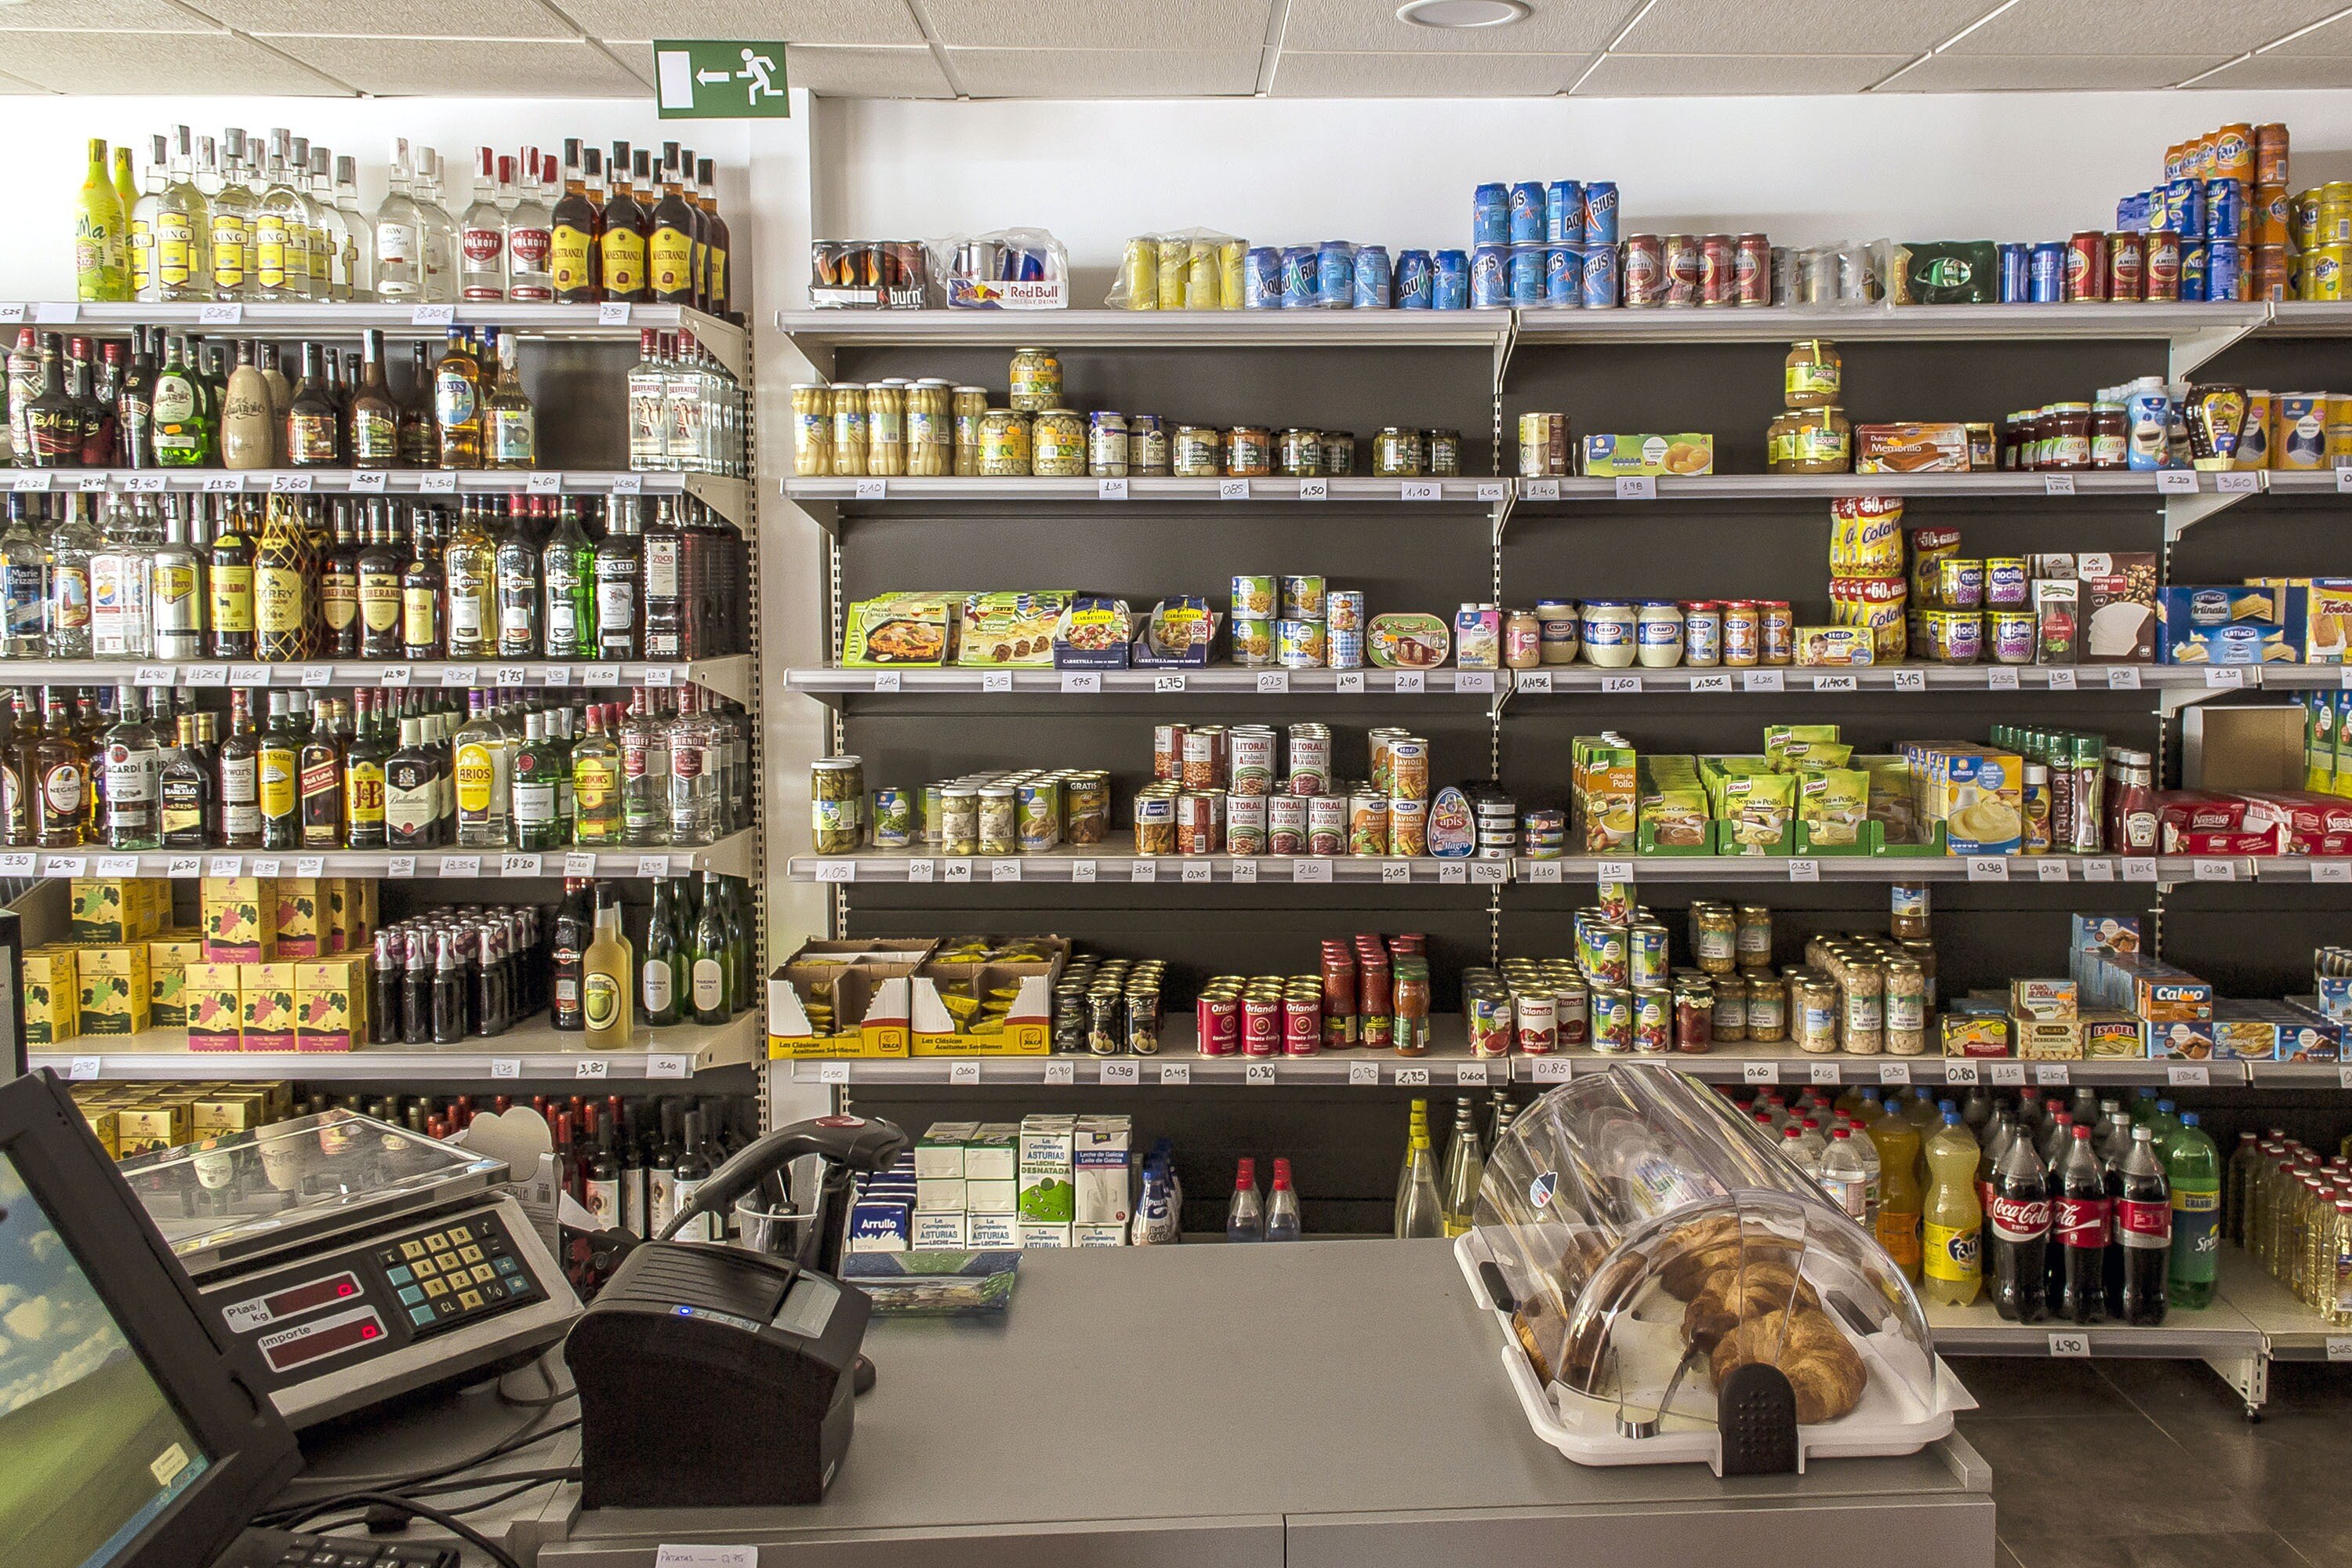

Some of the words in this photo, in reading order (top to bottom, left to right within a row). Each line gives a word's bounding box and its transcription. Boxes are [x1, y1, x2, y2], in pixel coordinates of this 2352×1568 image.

[890, 288, 919, 304] burn
[1011, 286, 1034, 298] Red
[1036, 285, 1058, 298] Bull
[1871, 443, 1921, 452] Membrillo
[274, 478, 307, 489] 5,60
[425, 478, 453, 488] 4.50
[532, 477, 555, 486] 4.60
[2220, 477, 2252, 489] 3,60
[1301, 485, 1324, 495] 1,50
[1406, 487, 1430, 496] 1,10
[1531, 485, 1555, 495] 1.40
[653, 554, 673, 563] ZOCO
[12, 569, 38, 579] Marie
[587, 669, 613, 680] 16.50
[1158, 676, 1181, 689] 1,75
[1398, 676, 1417, 687] 2.10
[1610, 679, 1634, 689] 1,60
[1236, 742, 1268, 750] LITORAL
[303, 776, 315, 785] Red
[316, 770, 333, 781] Label
[1070, 782, 1097, 790] GRATIS
[1229, 801, 1262, 810] LITORAL
[1269, 801, 1301, 810] LITORAL
[1814, 797, 1831, 805] Sopa
[1440, 818, 1463, 829] apis
[2194, 815, 2228, 827] Nestlé
[1443, 840, 1469, 851] Magro
[1385, 867, 1406, 878] 2,05
[1477, 866, 1501, 878] 0,98
[1246, 1004, 1277, 1013] Orlando
[1287, 1003, 1318, 1012] Orlando
[2095, 1026, 2136, 1036] ISABEL
[579, 1063, 603, 1073] 3,80
[1107, 1066, 1133, 1076] 0.98
[1538, 1063, 1566, 1074] 0.85
[1399, 1070, 1427, 1082] 2,85
[1029, 1143, 1063, 1152] Campesina
[1028, 1152, 1064, 1160] ASTURIAS
[1021, 1167, 1070, 1175] DESNATADA
[1994, 1196, 2051, 1225] Coca-Cola
[862, 1220, 896, 1229] Arrullo
[441, 1302, 456, 1314] CL
[252, 1312, 269, 1323] kg
[262, 1327, 311, 1348] Importe
